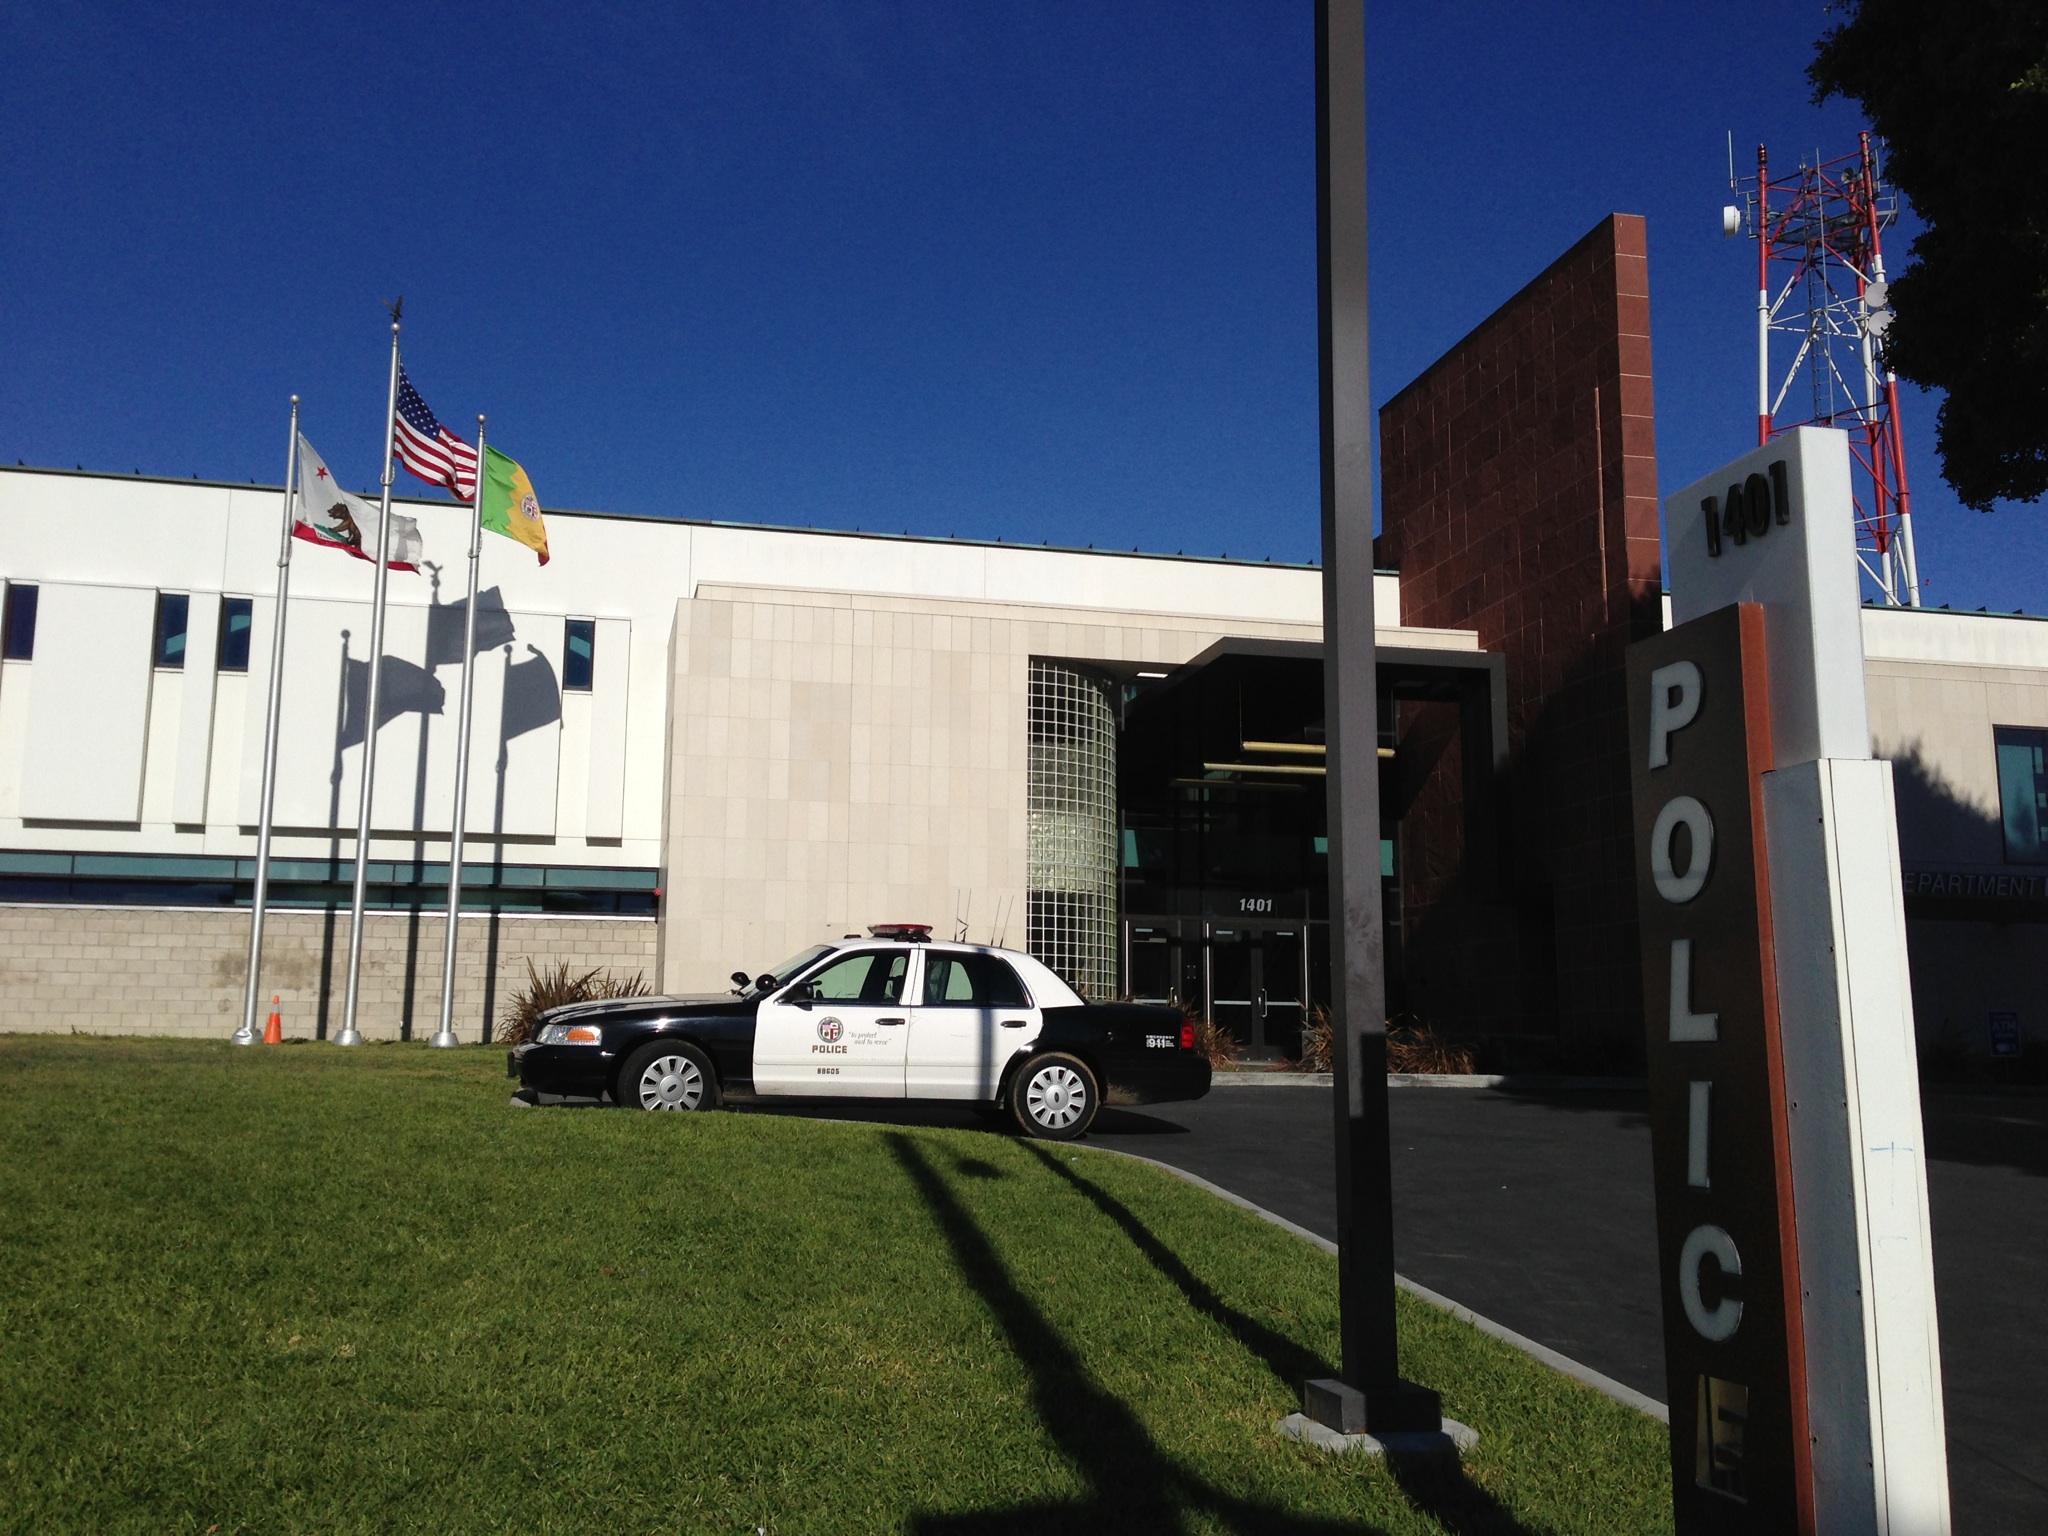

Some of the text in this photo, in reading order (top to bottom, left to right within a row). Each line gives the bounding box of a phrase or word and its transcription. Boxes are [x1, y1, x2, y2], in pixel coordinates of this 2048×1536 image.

[1700, 460, 1790, 557] 1401
[1903, 872, 2038, 896] EPARTMENT
[1239, 898, 1272, 912] 1401
[812, 1045, 848, 1054] POLICE
[1648, 660, 1748, 1503] POLICE
